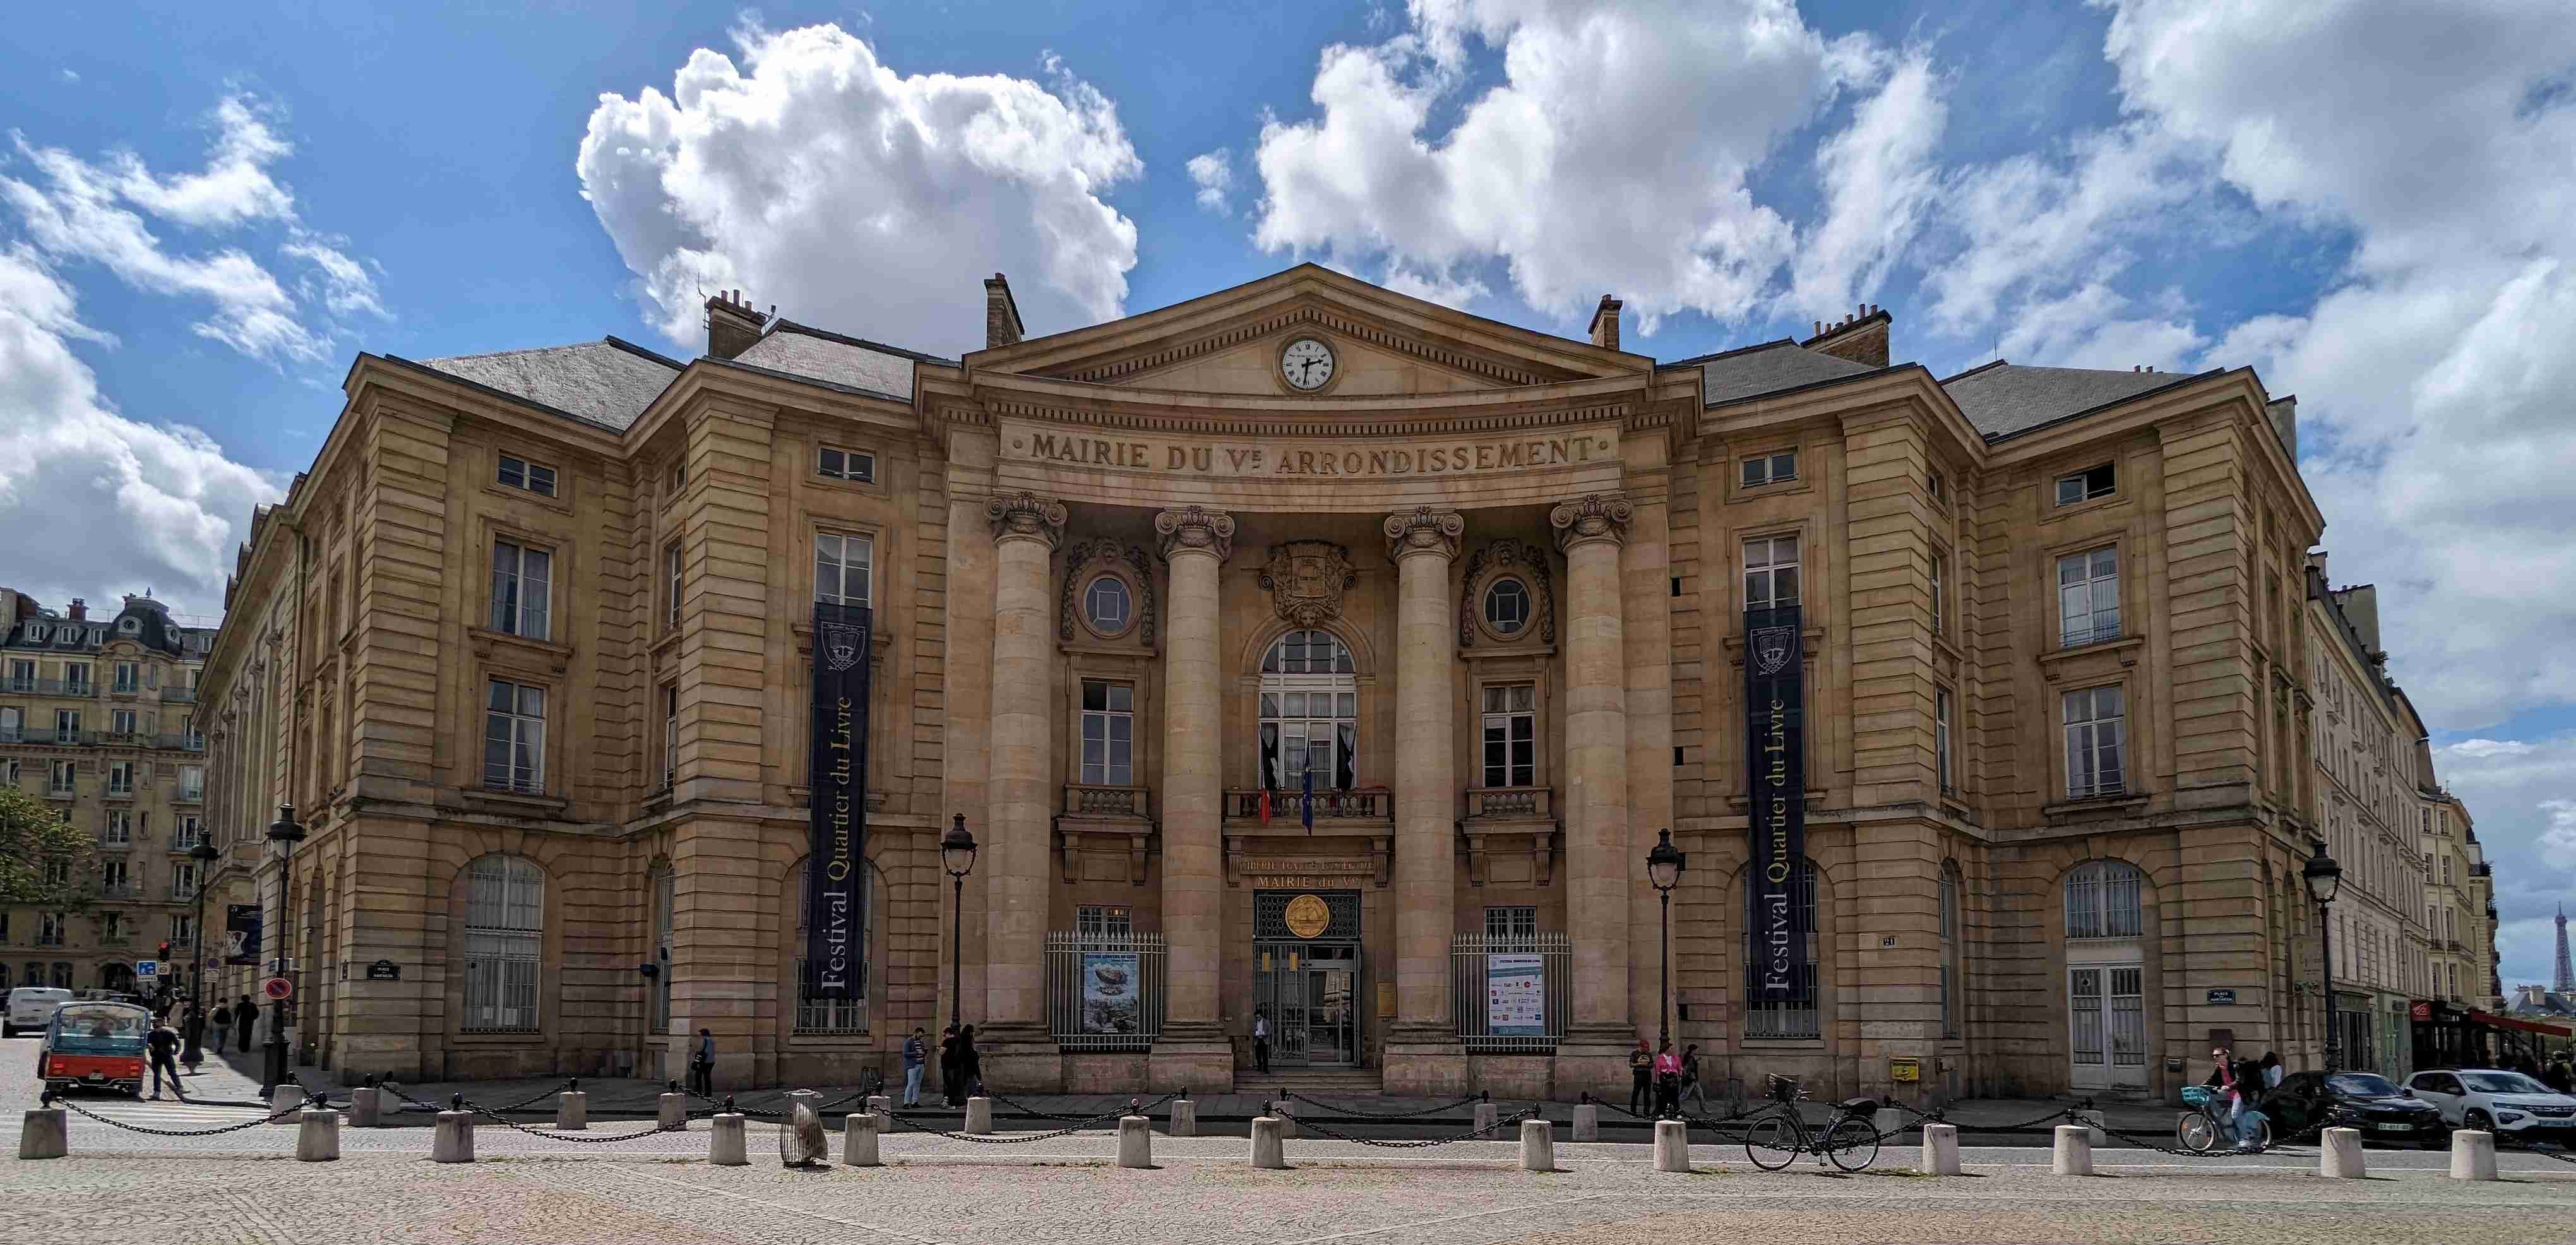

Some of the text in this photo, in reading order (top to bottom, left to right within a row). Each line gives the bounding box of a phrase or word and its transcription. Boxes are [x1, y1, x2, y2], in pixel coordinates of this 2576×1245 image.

[1030, 433, 1150, 468] MAIRIE
[1167, 444, 1213, 471] DU
[1276, 436, 1594, 475] ARRONDISSEMENT
[821, 696, 852, 990] Festival Quartier du Livre
[1257, 876, 1309, 888] MAIRIE
[1318, 878, 1334, 888] du
[1764, 698, 1789, 991] Festival Quartier du Livre
